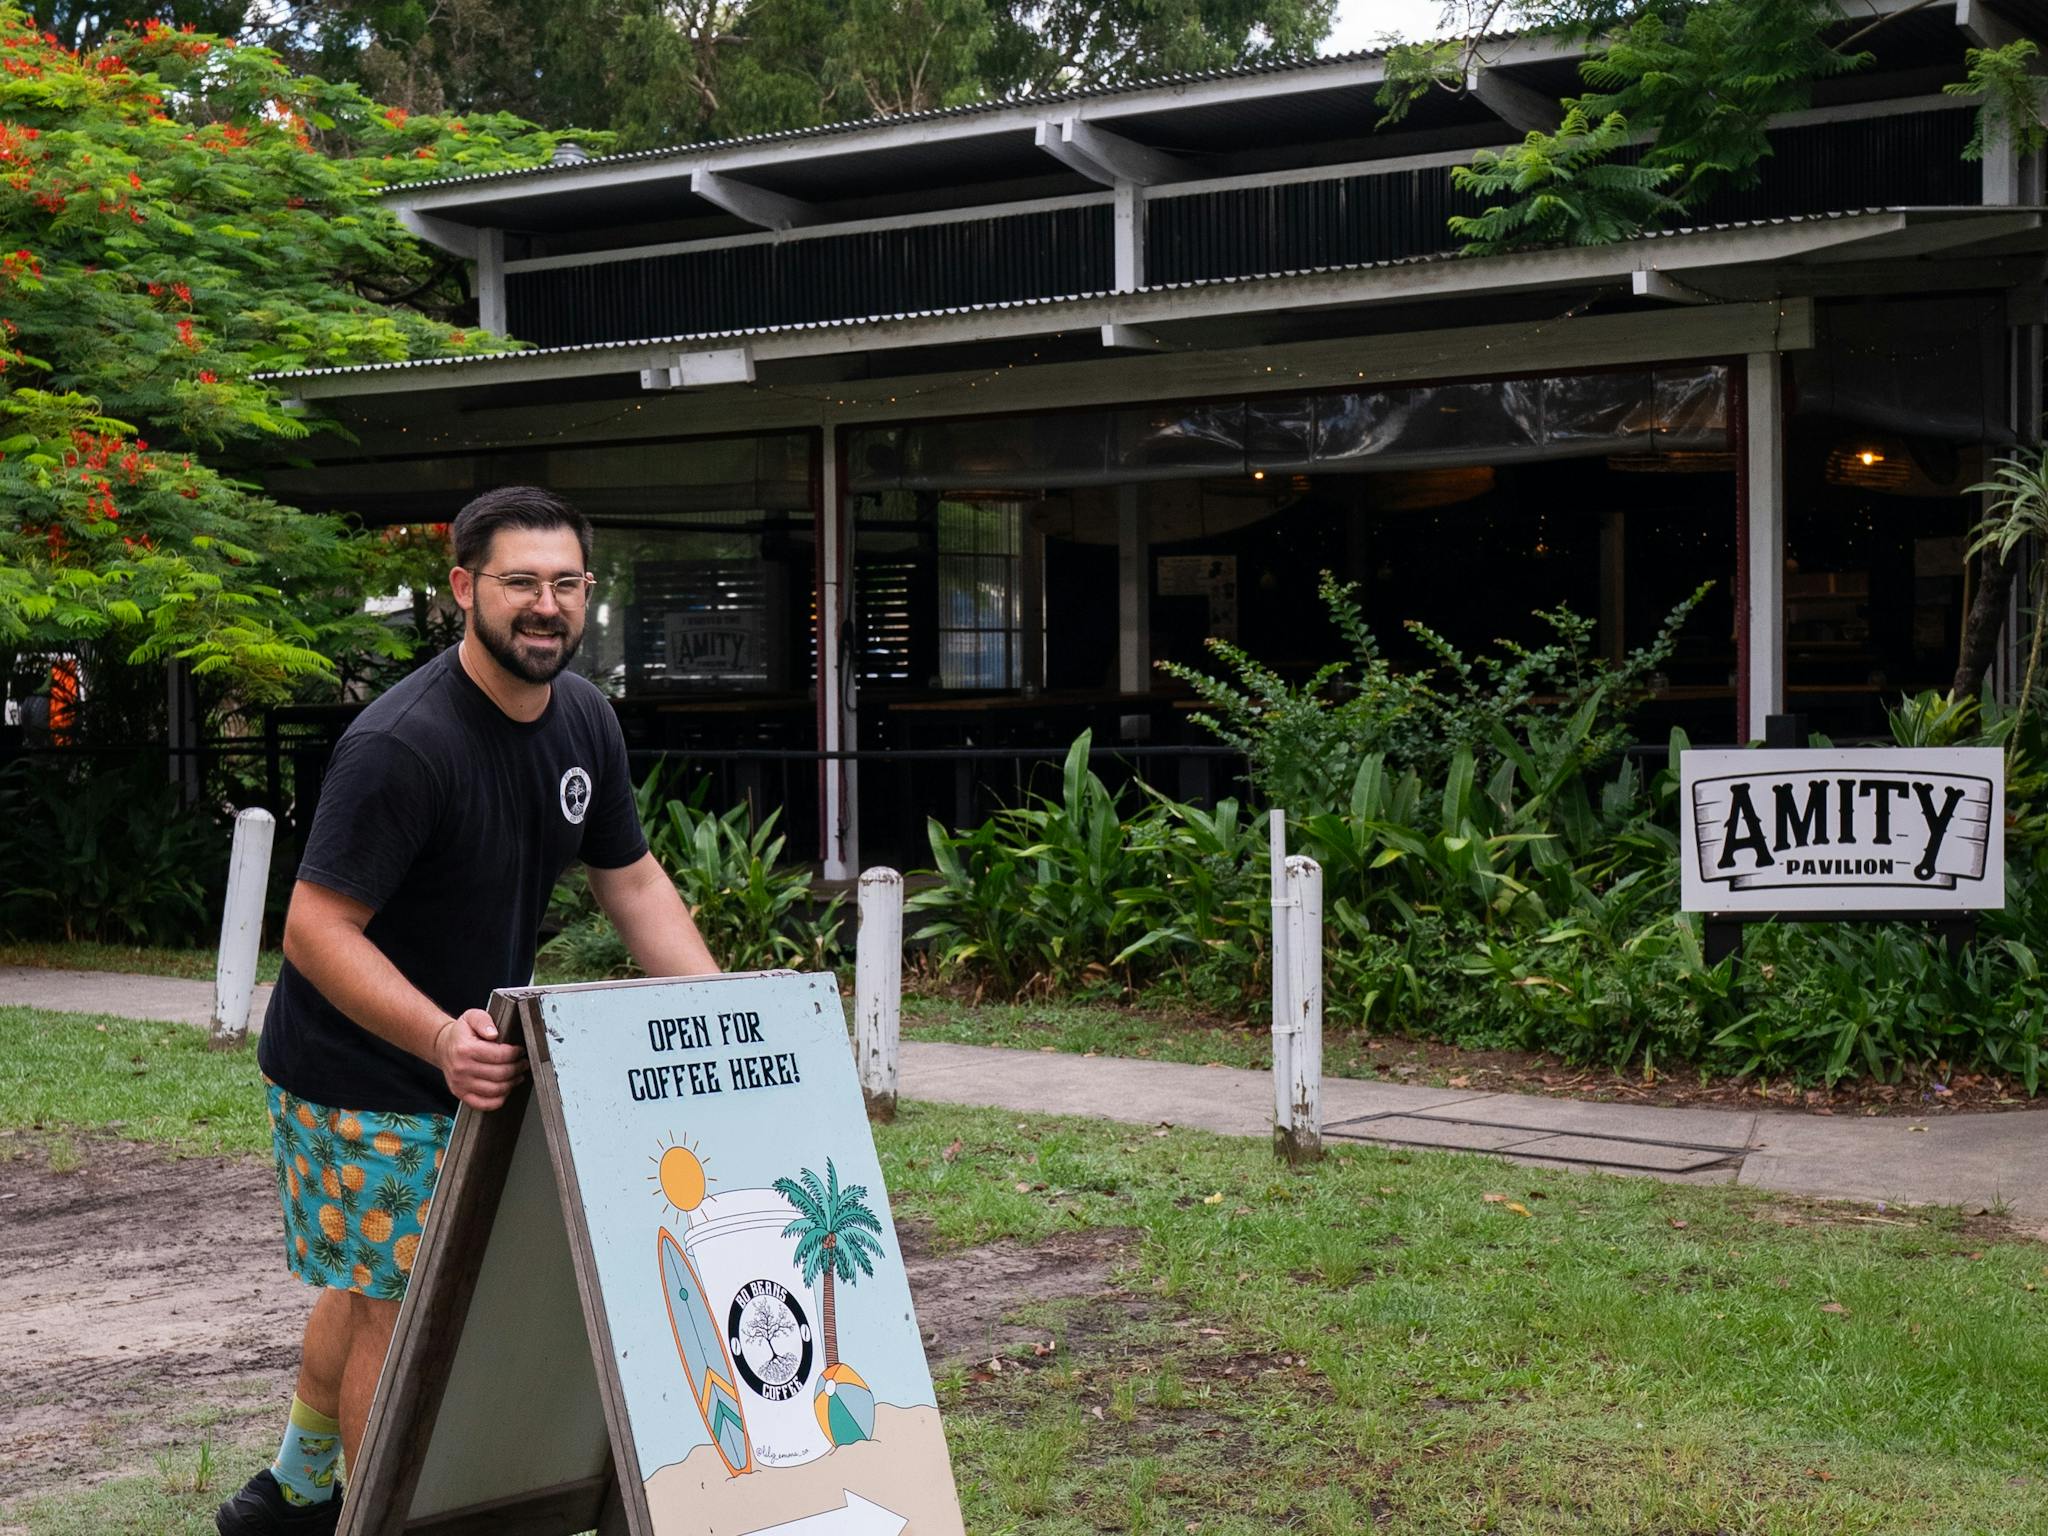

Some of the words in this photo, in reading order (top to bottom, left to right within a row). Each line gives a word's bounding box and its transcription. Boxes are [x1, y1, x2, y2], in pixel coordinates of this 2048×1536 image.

[1717, 779, 1965, 881] AMITY
[1786, 858, 1894, 875] PAVILION
[648, 1015, 712, 1052] OPEN
[717, 1012, 764, 1046] FOR
[628, 1061, 722, 1101] COFFEE
[728, 1053, 801, 1091] HERE!
[735, 1287, 751, 1309] BO
[750, 1280, 788, 1302] BEANS
[761, 1375, 803, 1401] COFFEE
